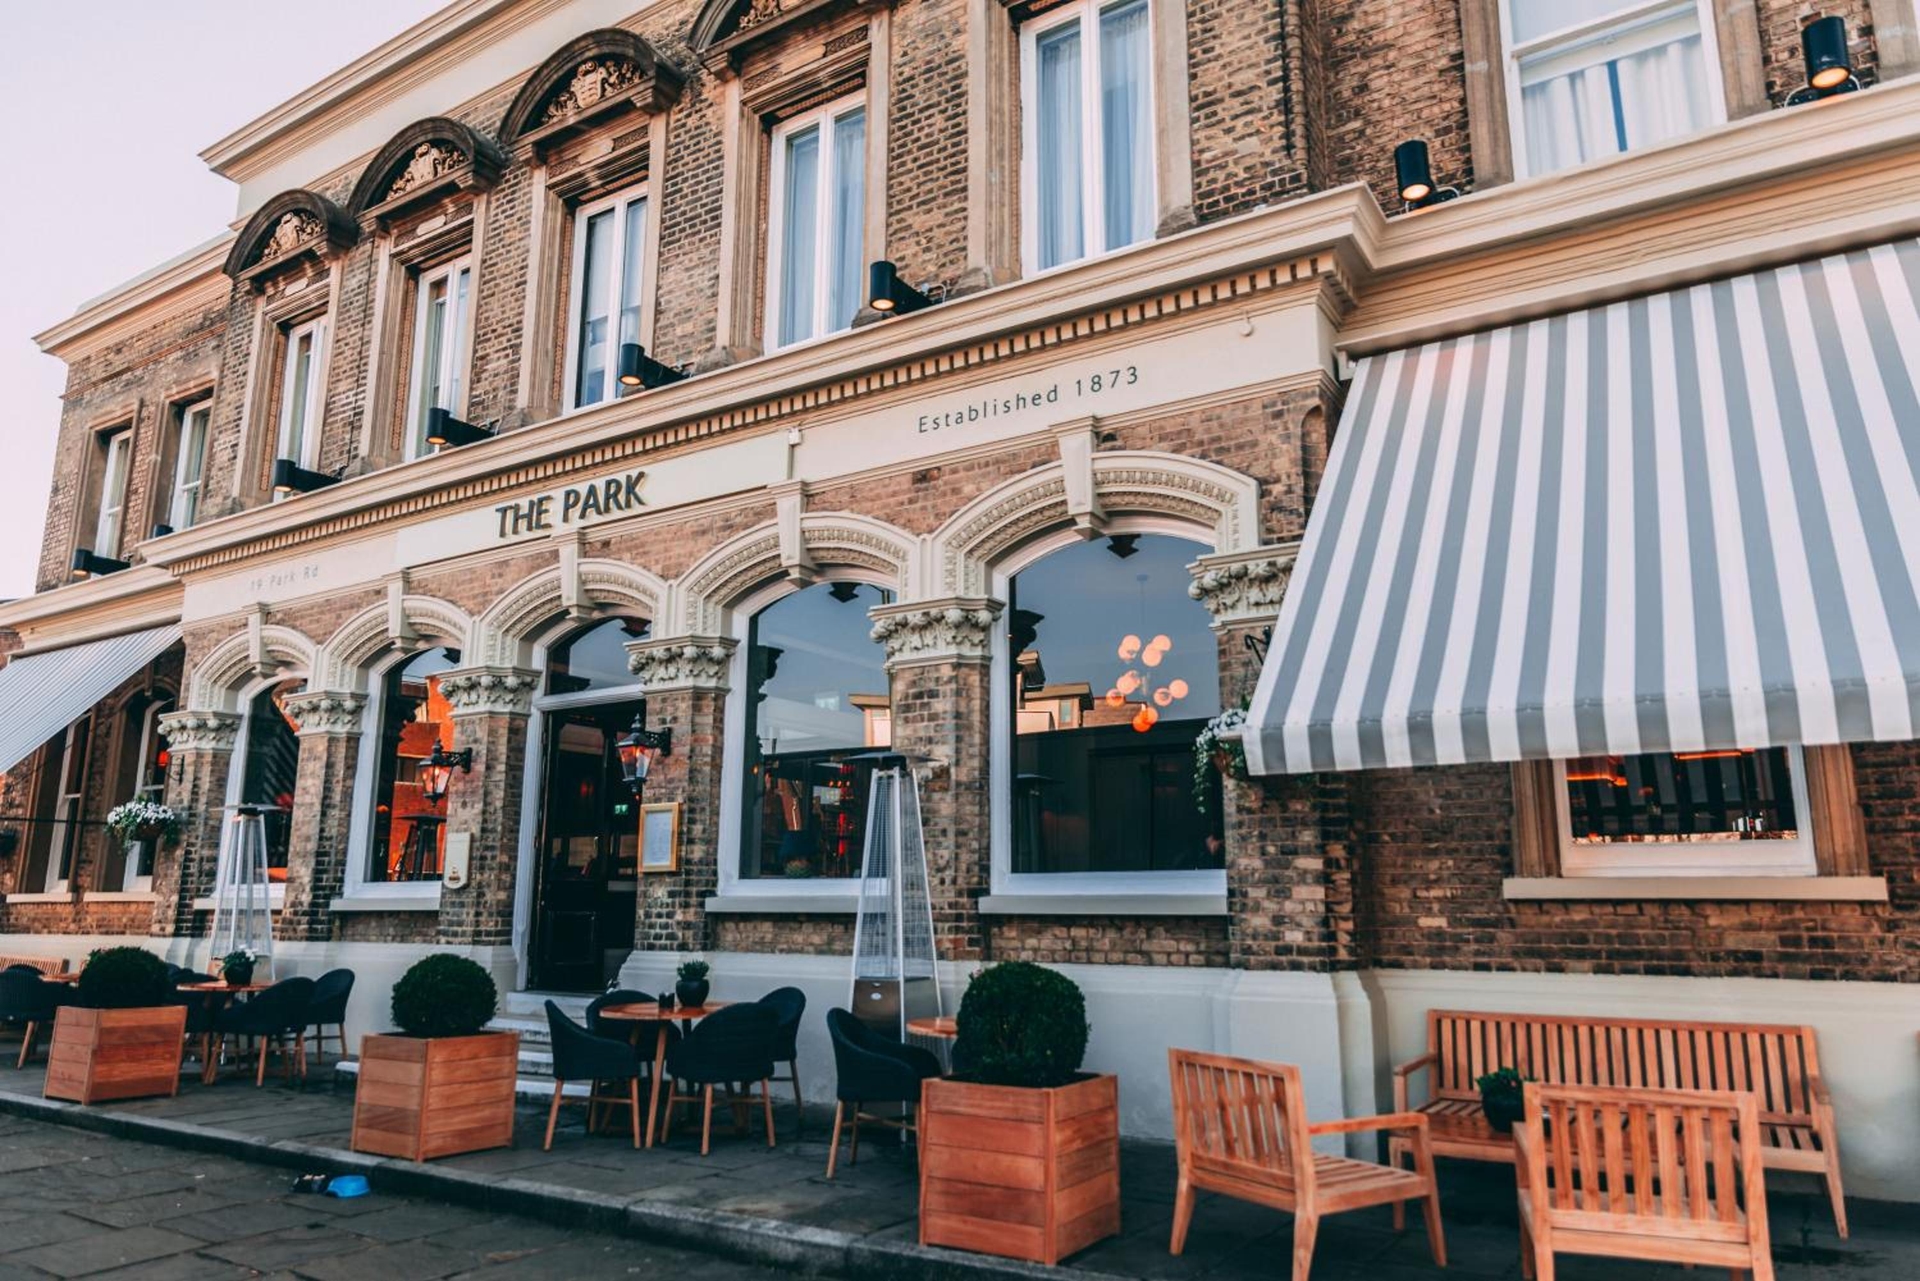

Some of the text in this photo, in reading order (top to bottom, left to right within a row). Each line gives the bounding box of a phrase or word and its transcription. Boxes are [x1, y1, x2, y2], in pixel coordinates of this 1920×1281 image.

[918, 366, 1138, 433] Established 1873
[495, 471, 646, 538] THE PARK
